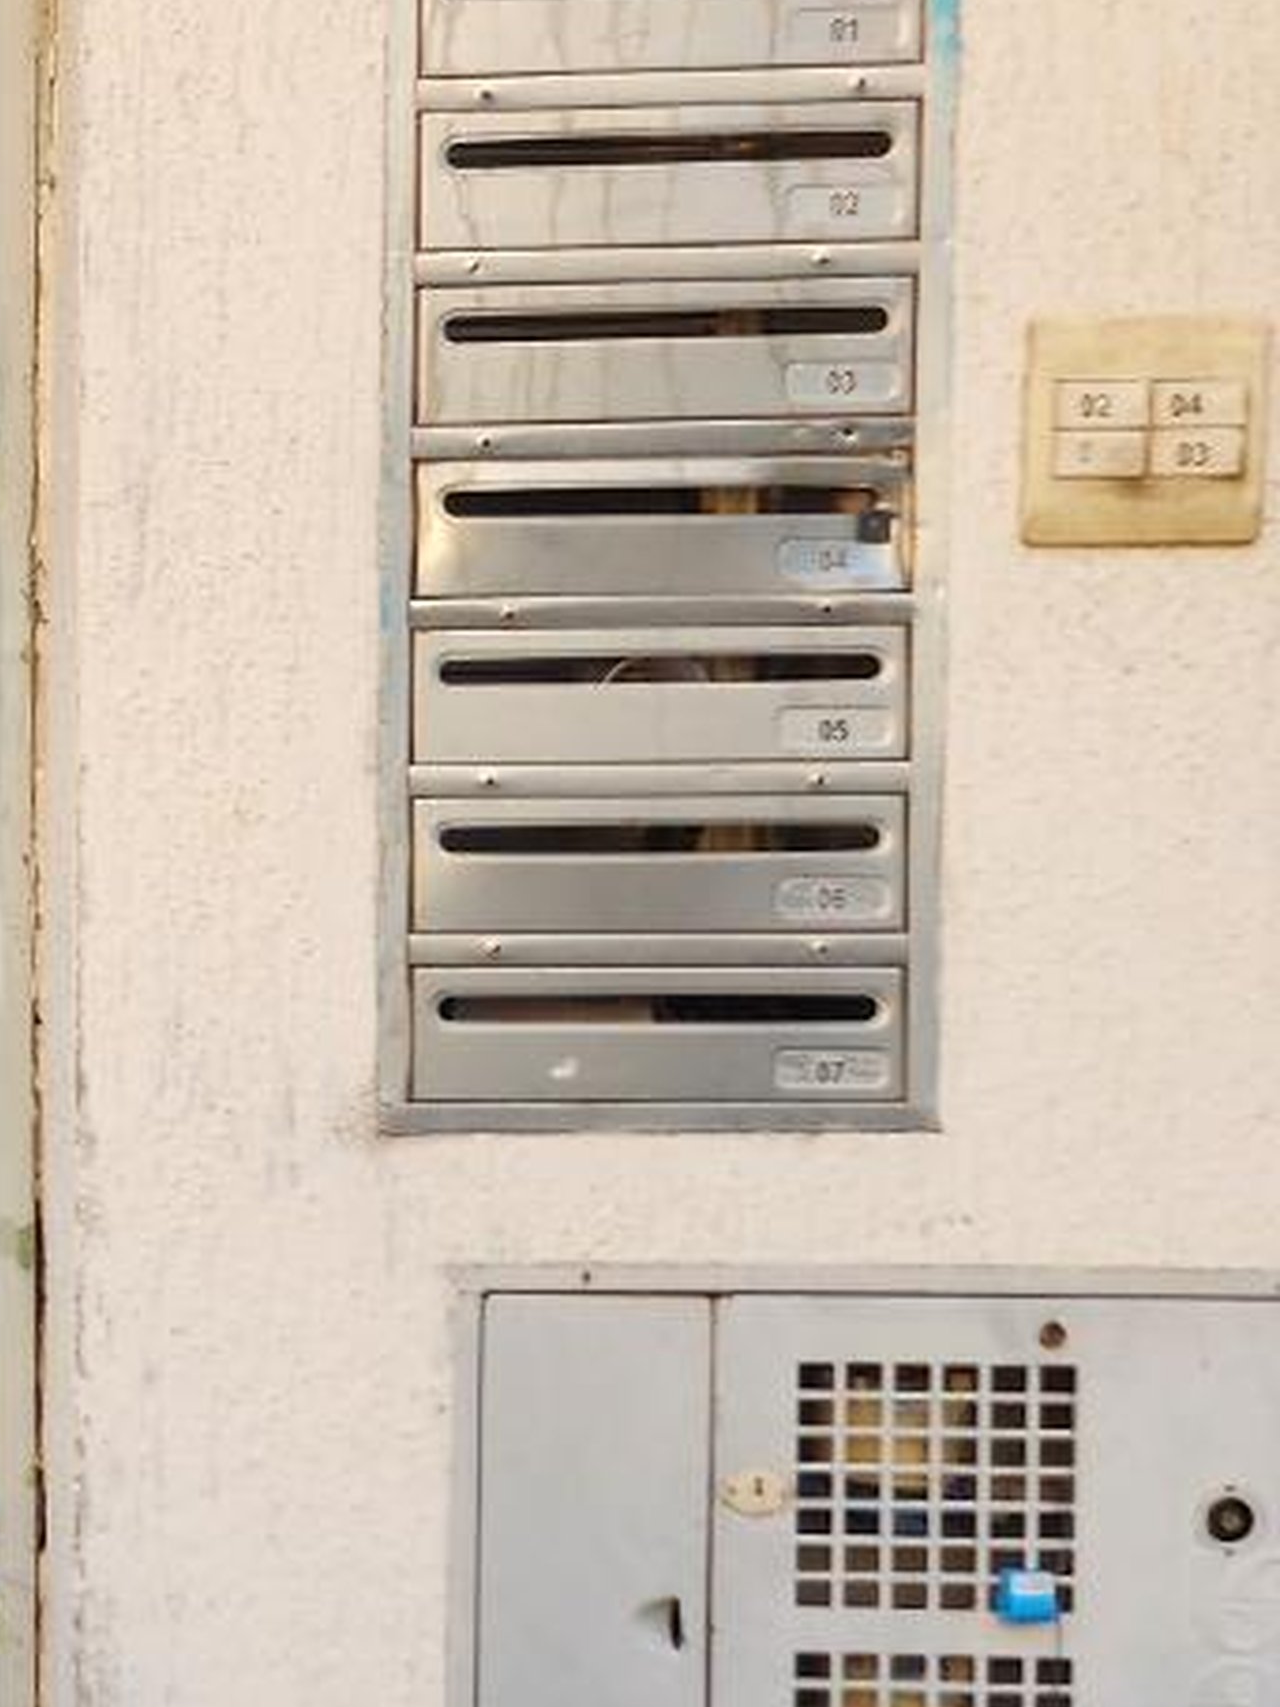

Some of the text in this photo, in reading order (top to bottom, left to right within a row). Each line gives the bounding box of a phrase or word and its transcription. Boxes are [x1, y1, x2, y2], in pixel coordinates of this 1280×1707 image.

[829, 17, 858, 42] 01
[829, 190, 859, 216] 02
[826, 368, 857, 394] 03
[818, 718, 849, 742] 05
[815, 1060, 846, 1084] 07
